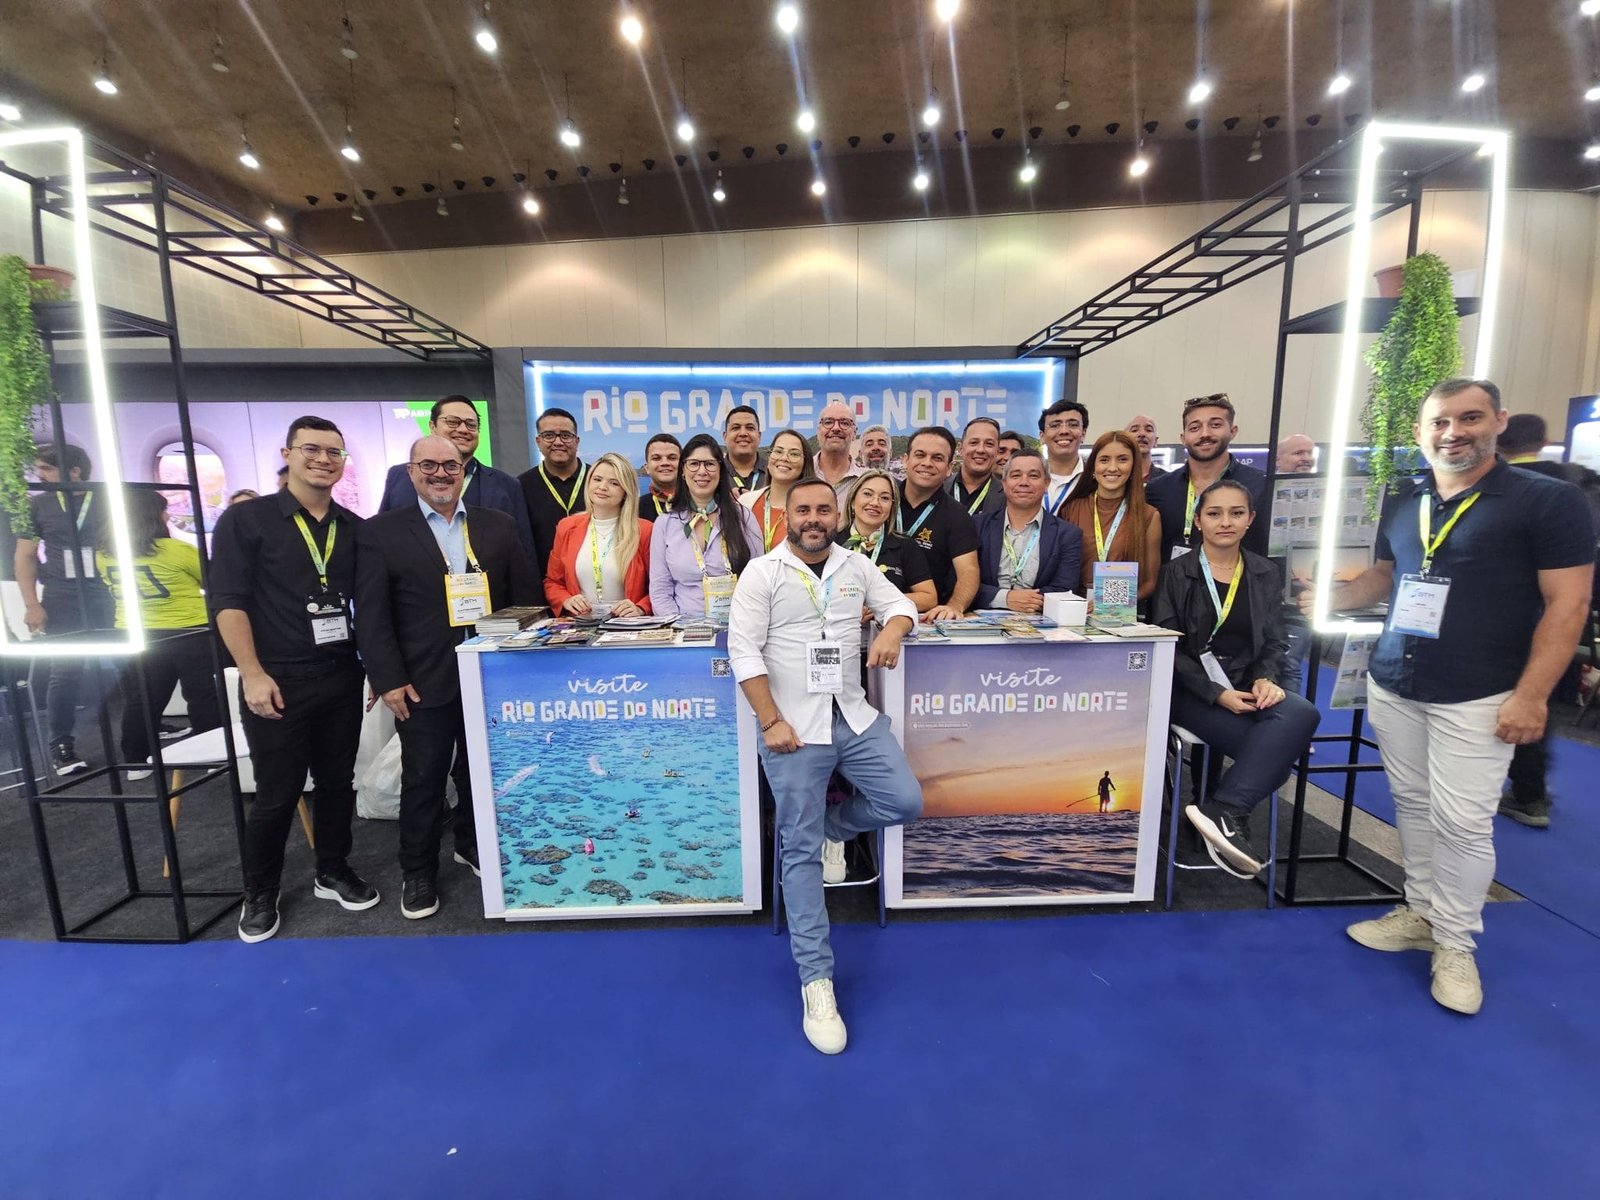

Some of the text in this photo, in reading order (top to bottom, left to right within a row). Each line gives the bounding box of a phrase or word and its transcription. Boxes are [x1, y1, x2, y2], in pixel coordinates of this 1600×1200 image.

[659, 389, 814, 434] GRANDE
[882, 387, 1007, 431] NORTE
[567, 673, 648, 694] visite
[980, 667, 1062, 688] visite
[540, 699, 618, 722] GRANDE
[652, 697, 716, 720] NORTE
[949, 693, 1028, 715] GRANDE
[1062, 691, 1128, 712] NORTE
